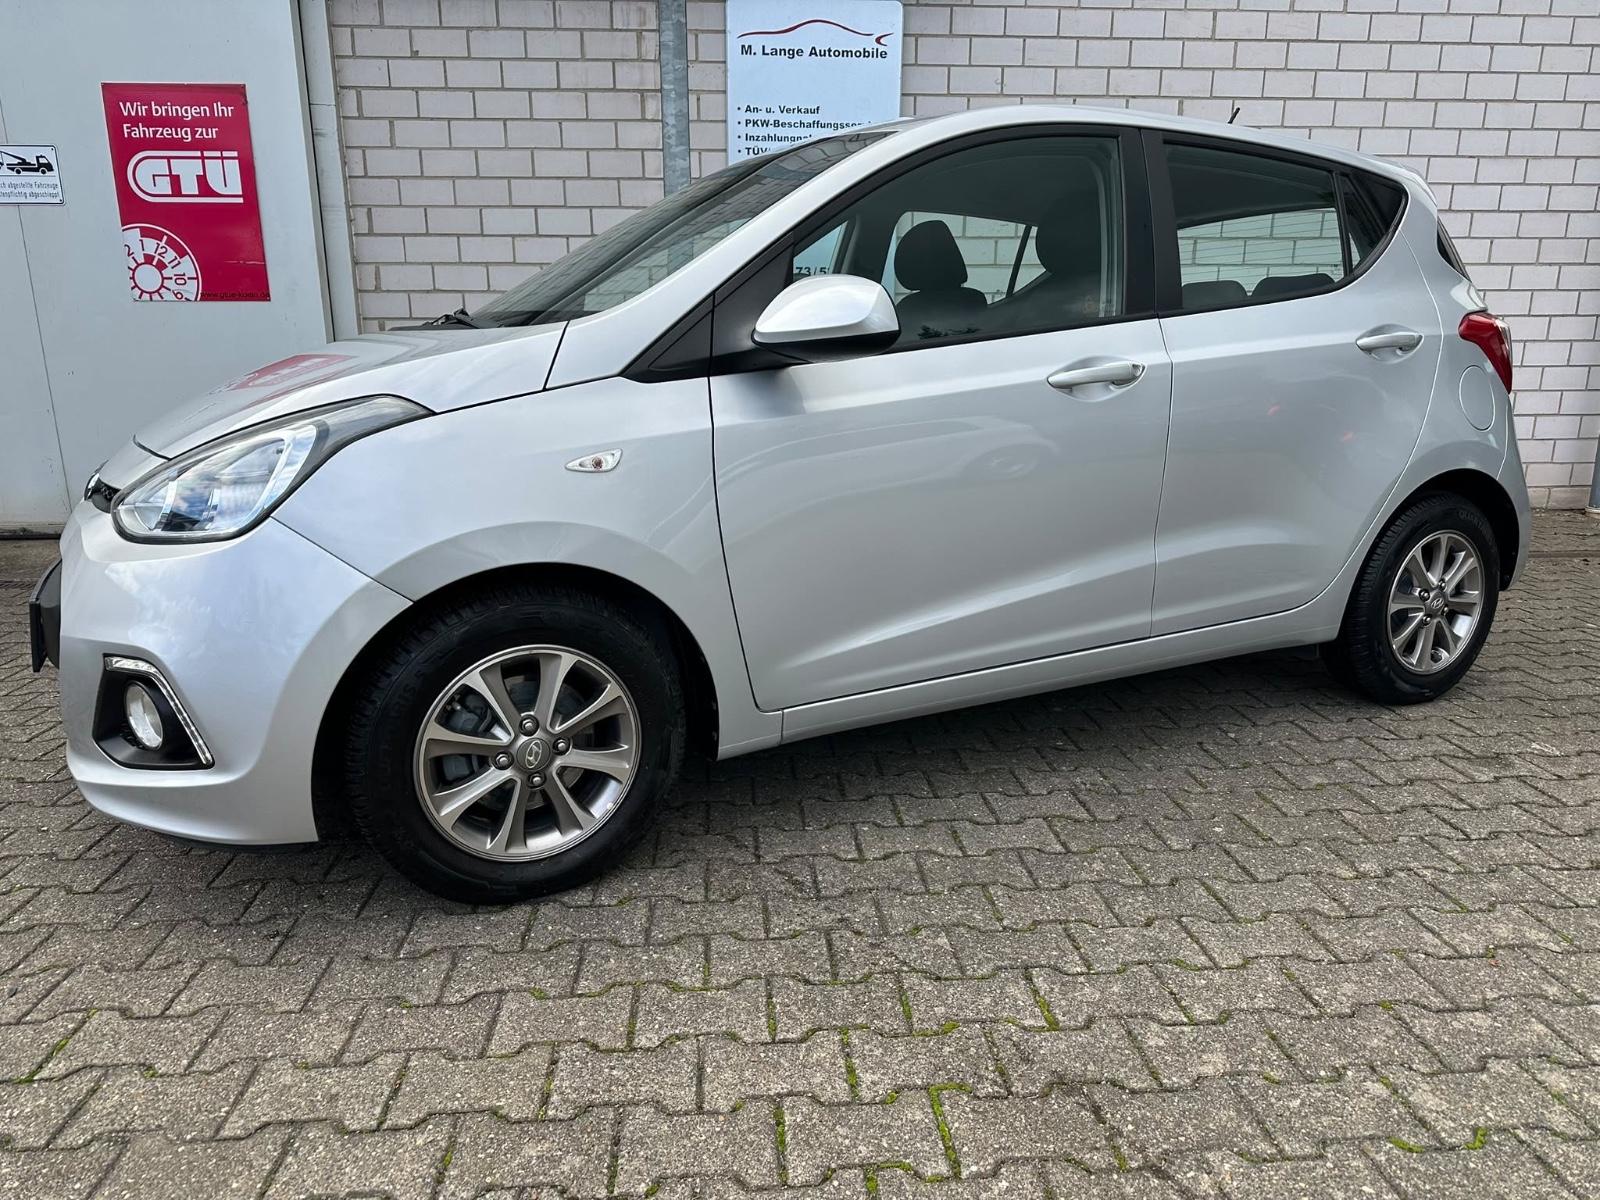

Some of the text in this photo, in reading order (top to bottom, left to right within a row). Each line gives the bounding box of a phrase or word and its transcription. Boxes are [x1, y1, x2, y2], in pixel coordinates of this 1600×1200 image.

[740, 44, 888, 59] M. Lange Automobile
[119, 101, 234, 120] Wir bringen Ihr
[744, 104, 821, 115] An- u. Verkauf
[122, 123, 219, 142] Fahrzeug zur
[745, 145, 771, 155] TÜV
[128, 150, 243, 202] GTÜ
[123, 243, 135, 258] 2
[138, 238, 145, 252] 1
[154, 242, 168, 259] 12
[167, 255, 182, 270] 11
[173, 272, 188, 286] 10
